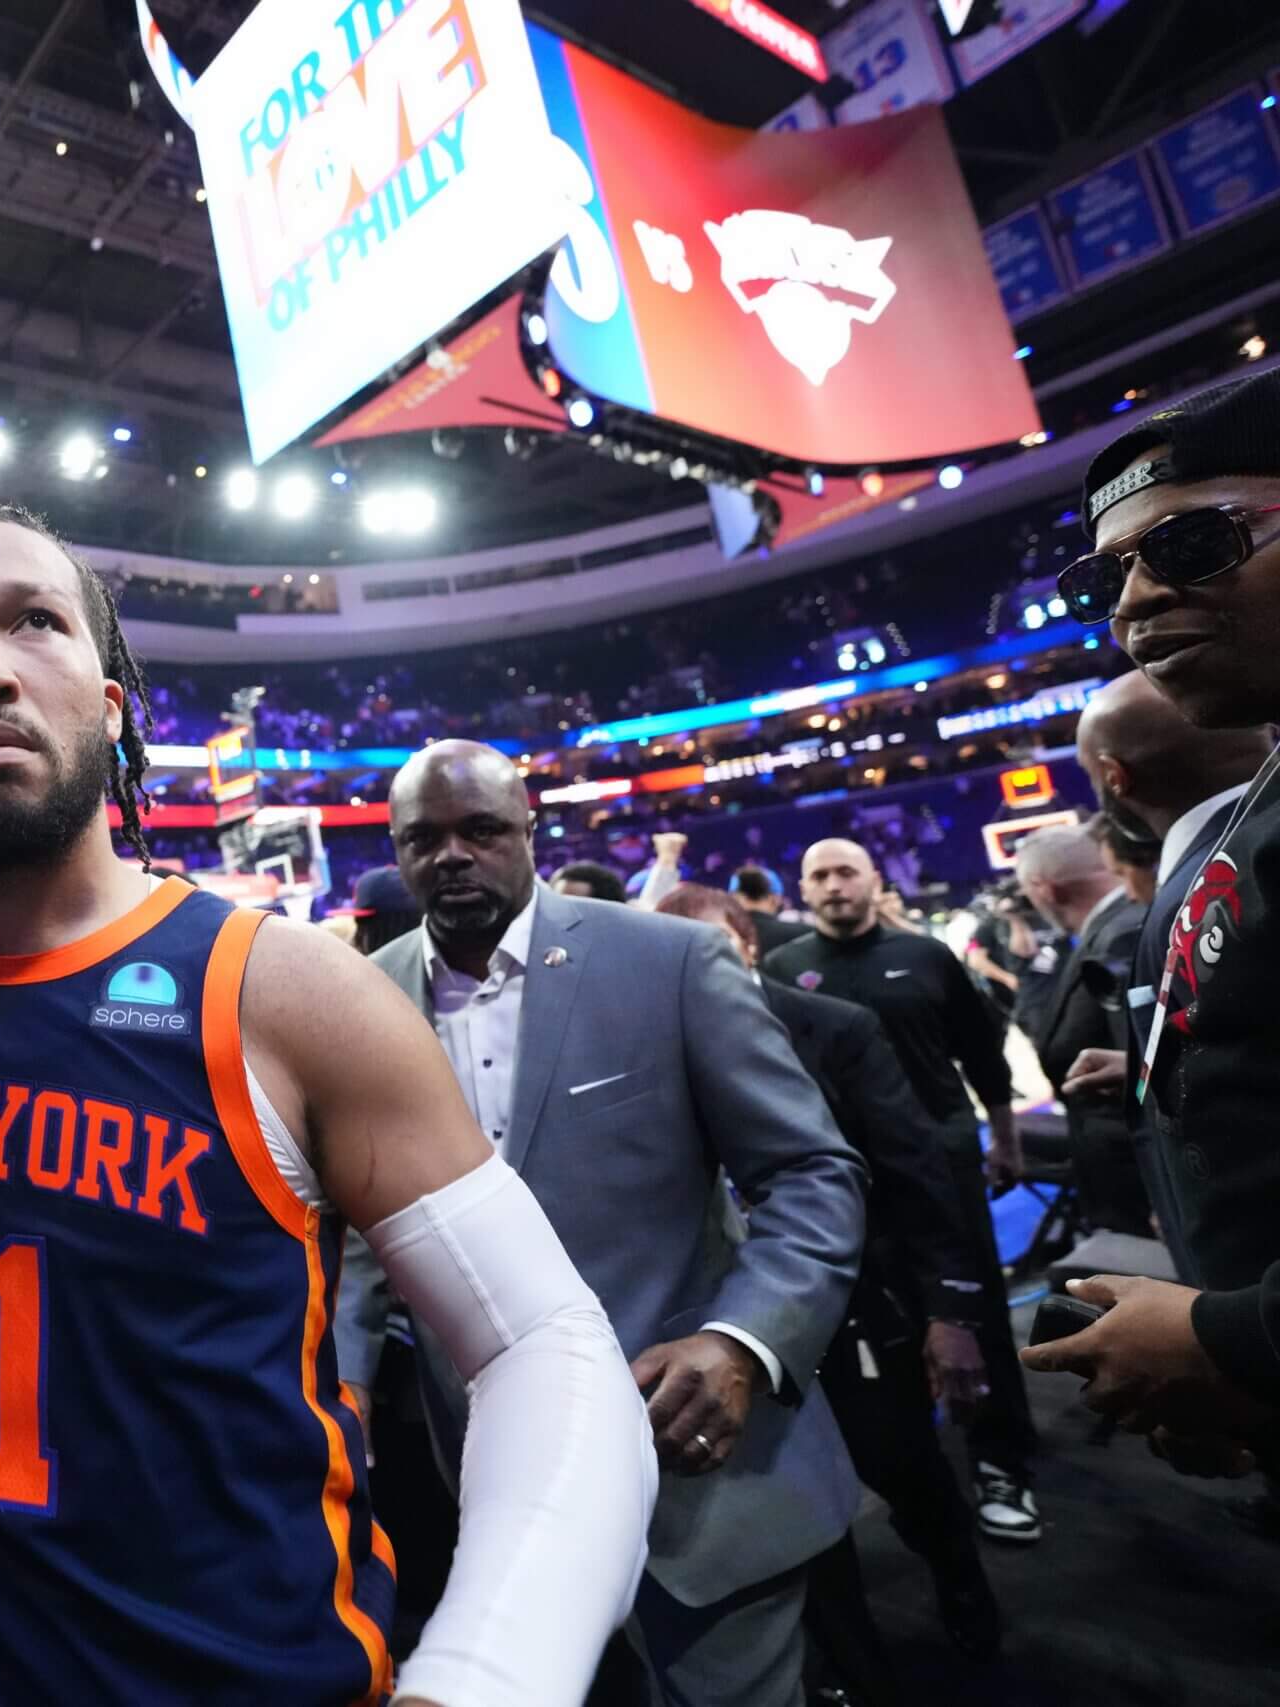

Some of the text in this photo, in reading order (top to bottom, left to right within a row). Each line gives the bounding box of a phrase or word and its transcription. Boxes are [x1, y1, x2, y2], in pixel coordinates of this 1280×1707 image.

[238, 0, 488, 308] LOVE
[239, 0, 406, 178] FOR TH
[267, 110, 466, 332] OF PHILLY
[95, 1008, 185, 1029] sphere
